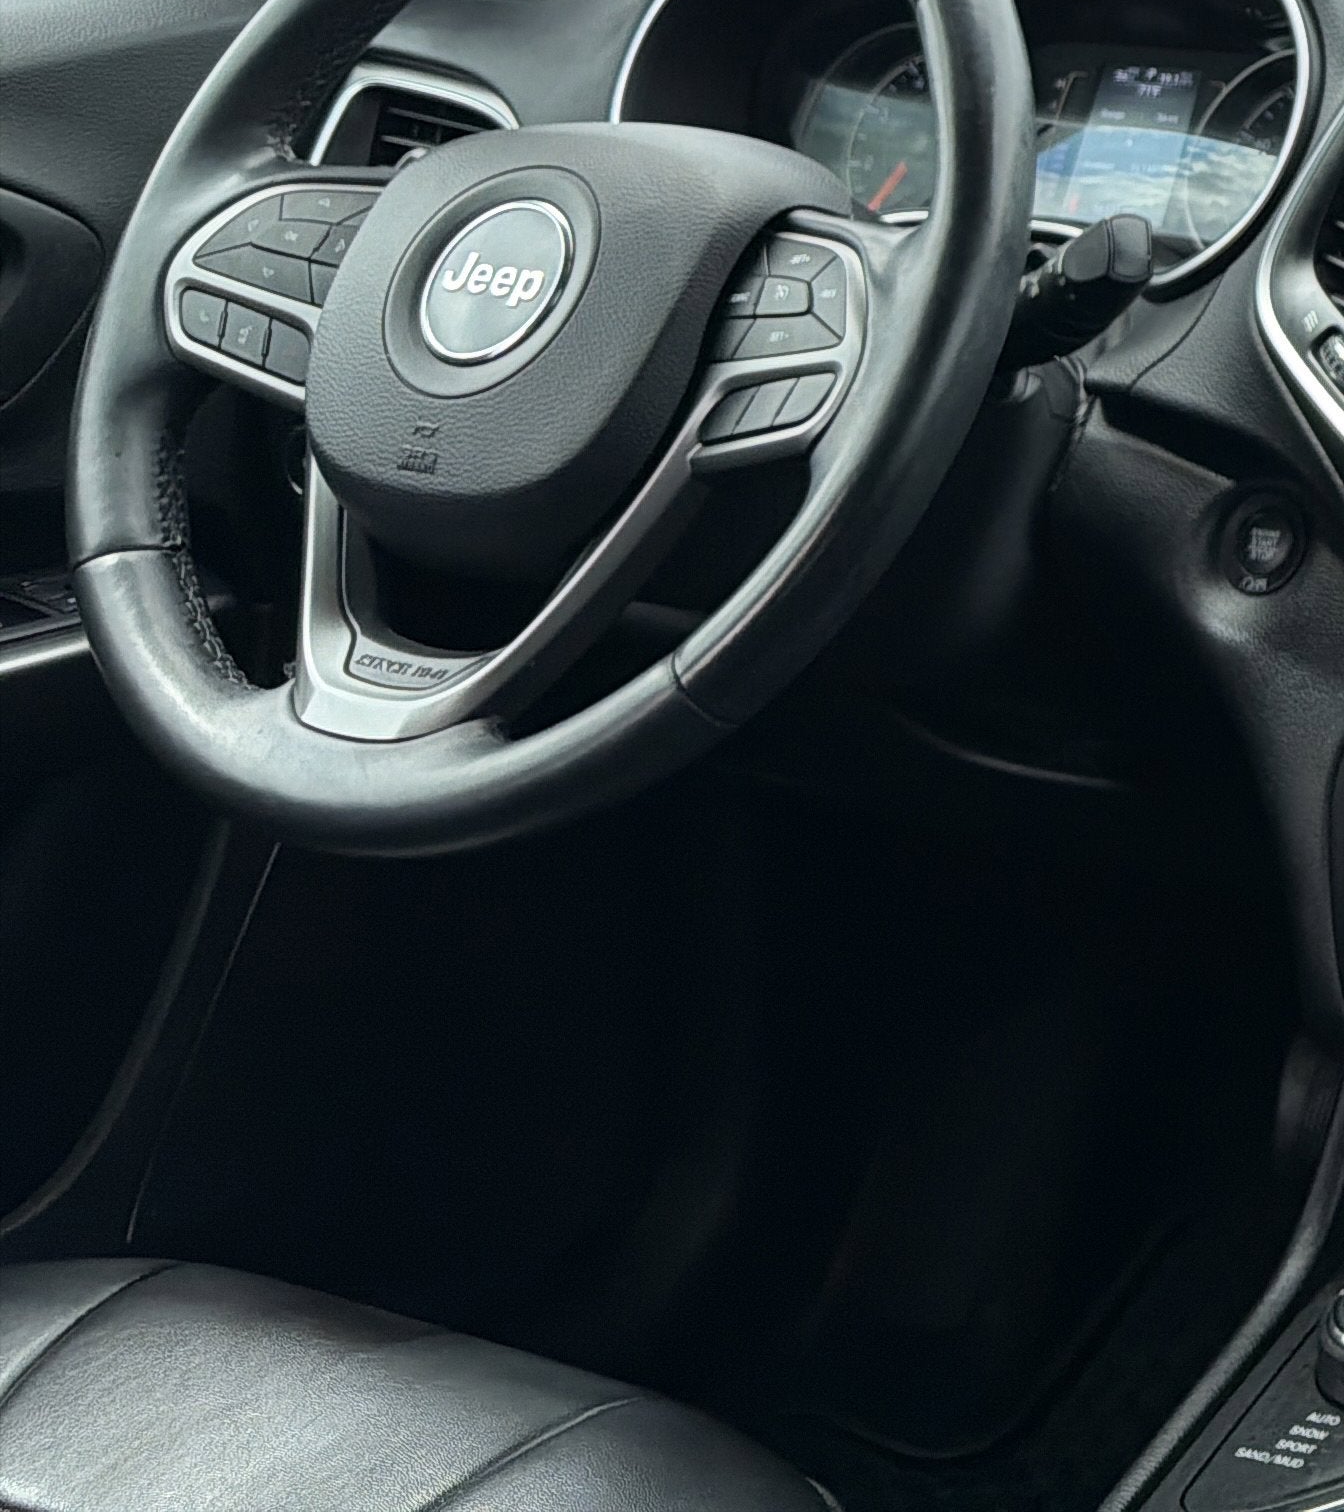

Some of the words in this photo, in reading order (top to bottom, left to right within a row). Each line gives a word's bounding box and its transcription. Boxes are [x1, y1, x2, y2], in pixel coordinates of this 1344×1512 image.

[442, 251, 545, 308] Jeep
[1305, 1411, 1341, 1426] AUTO
[1289, 1424, 1330, 1440] SNOW
[1275, 1438, 1318, 1455] SPORT
[1234, 1446, 1305, 1469] SAND/MUD
